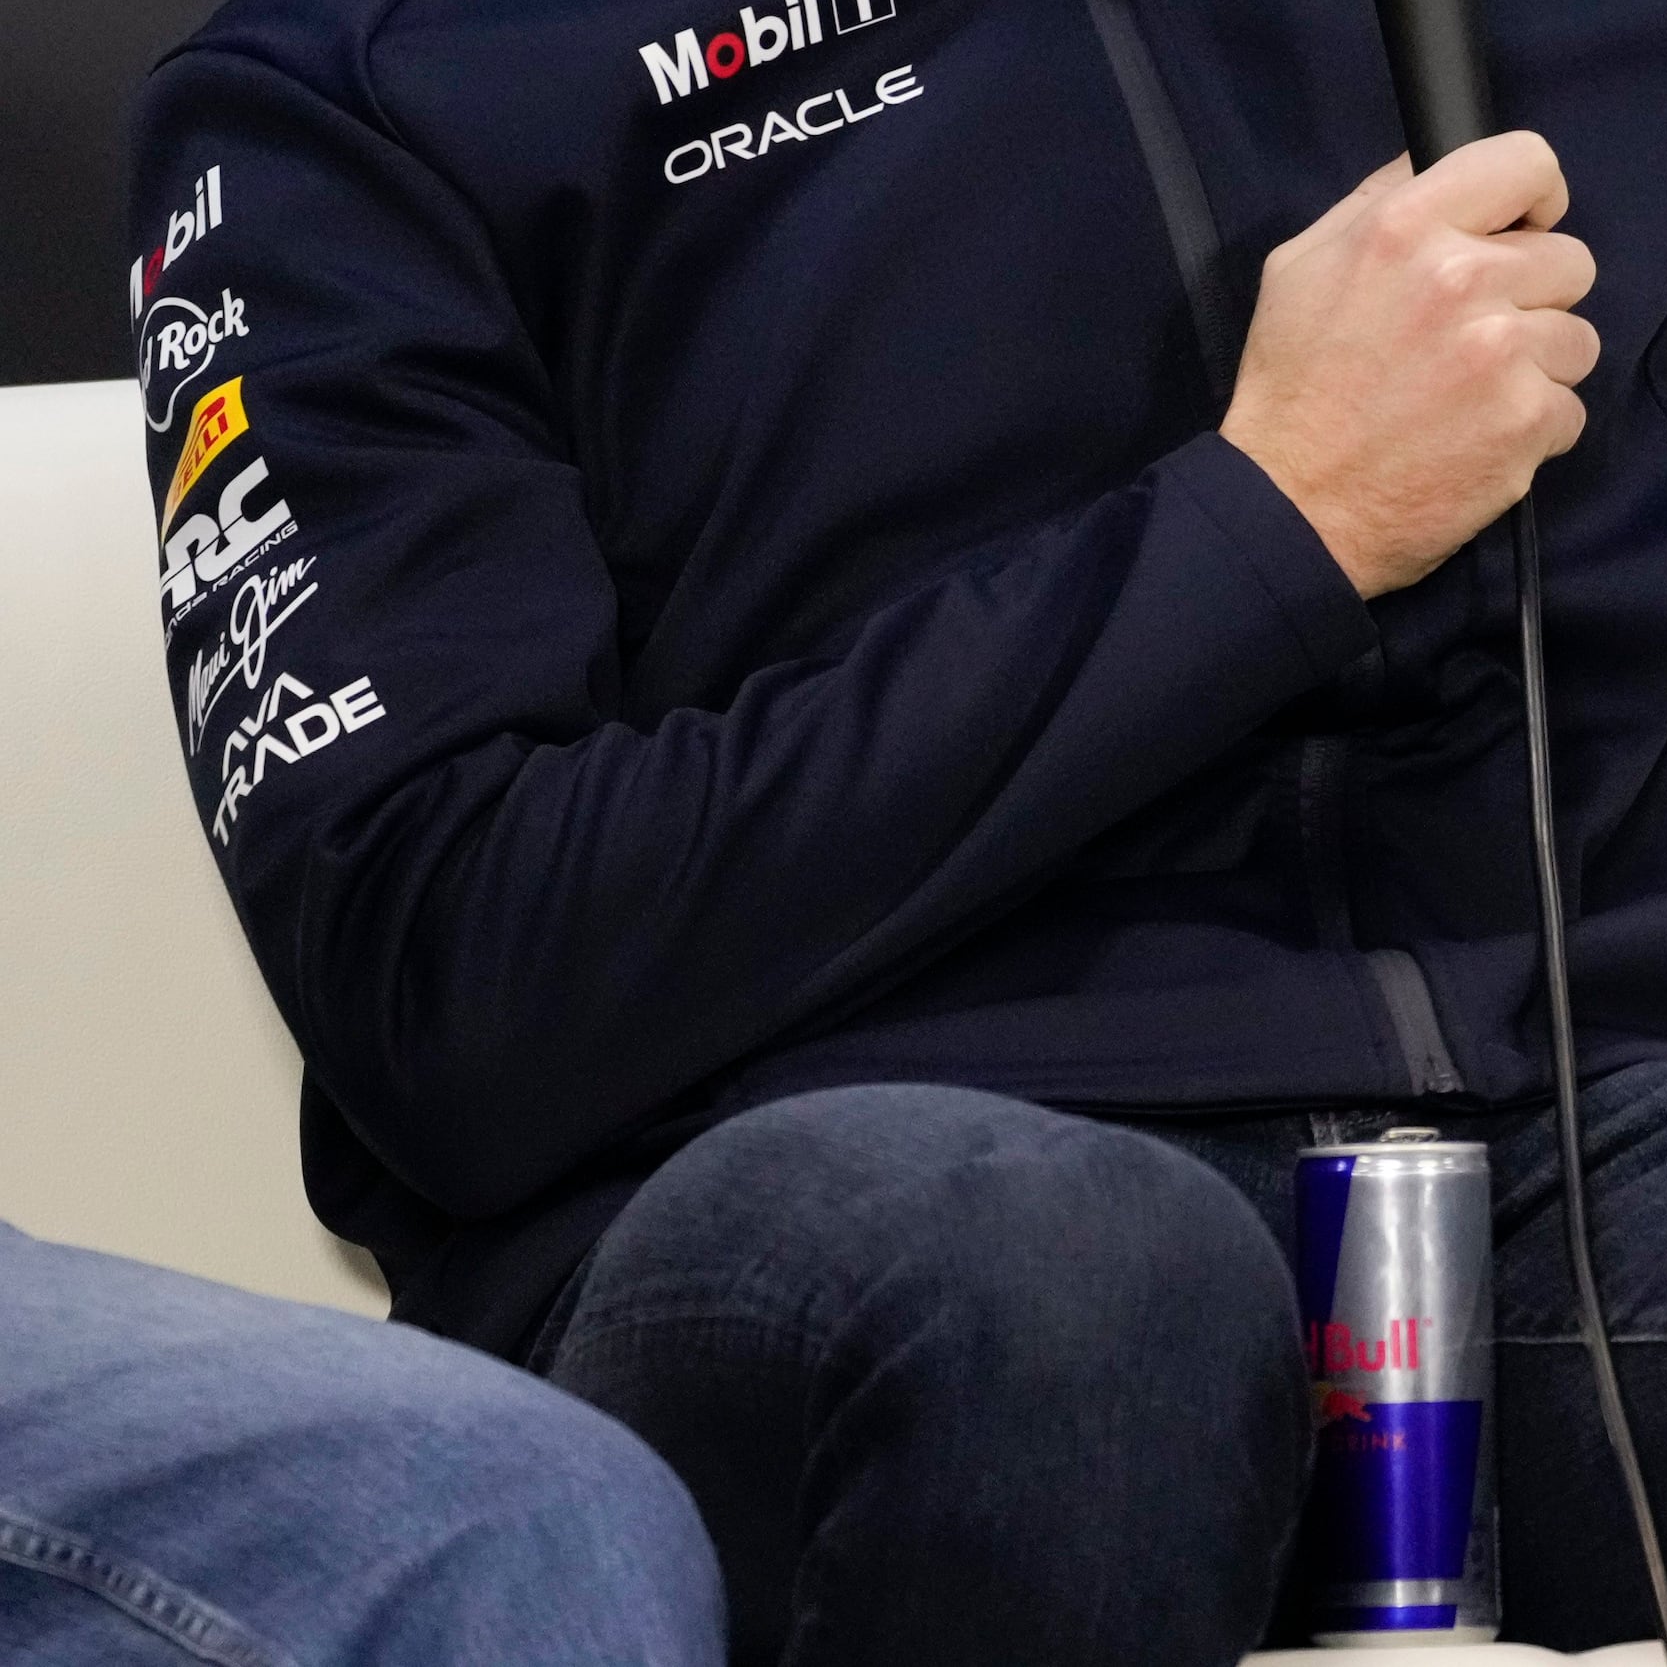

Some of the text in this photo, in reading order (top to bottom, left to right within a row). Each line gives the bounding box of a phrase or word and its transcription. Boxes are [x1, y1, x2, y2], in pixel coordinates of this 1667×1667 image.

[664, 64, 924, 184] ORACLE
[157, 287, 250, 371] Rock
[172, 396, 229, 506] ELLI
[212, 519, 299, 592] RACING
[188, 556, 316, 757] Maui Jim
[213, 676, 387, 847] TRADE
[1325, 1317, 1419, 1373] Bull
[1333, 1431, 1406, 1453] RINK
